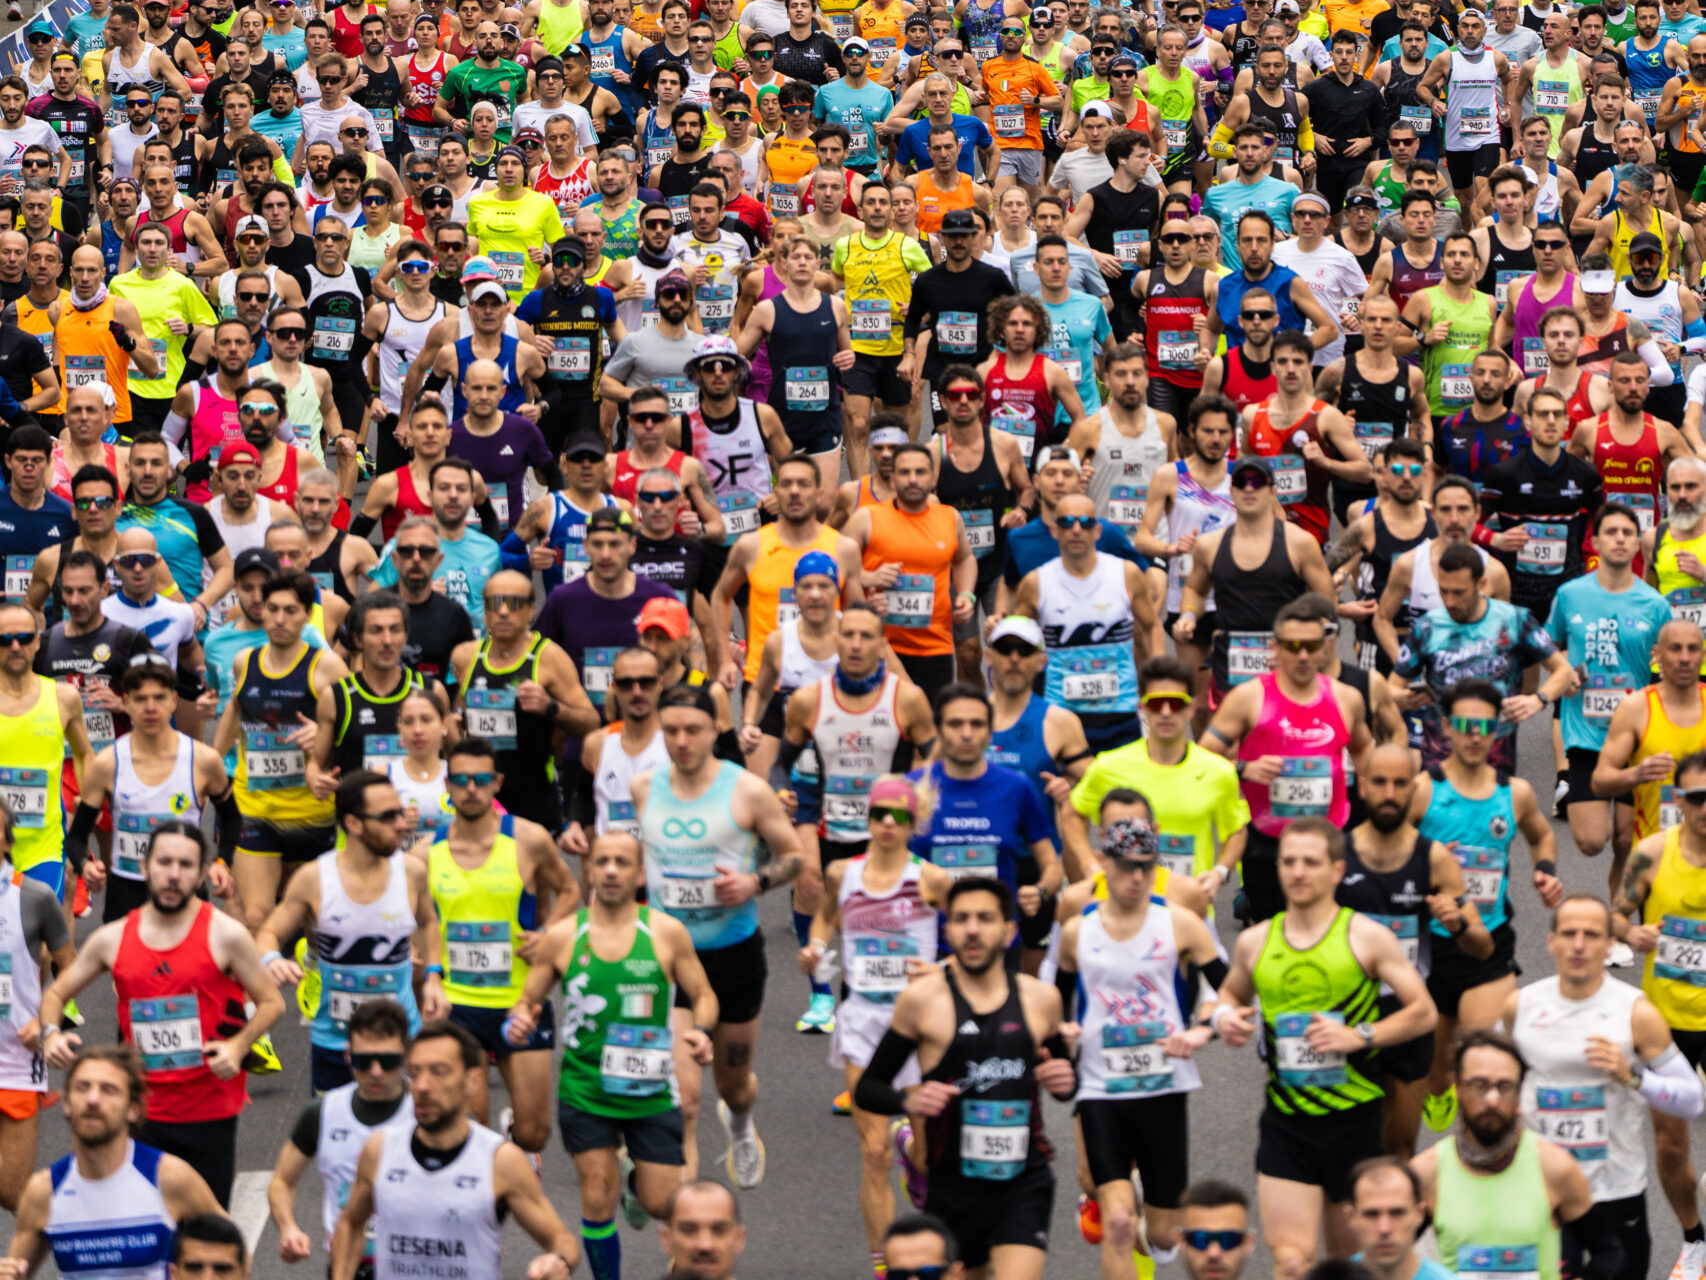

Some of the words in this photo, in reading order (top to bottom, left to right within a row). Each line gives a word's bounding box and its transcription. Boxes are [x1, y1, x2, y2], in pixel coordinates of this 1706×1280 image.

[837, 27, 850, 36] 588
[875, 51, 890, 60] 1032
[591, 59, 610, 70] 2466
[1546, 96, 1558, 105] 710
[1641, 101, 1658, 111] 1239
[849, 107, 862, 115] RO
[1001, 118, 1017, 128] 1027
[1469, 121, 1483, 130] 940
[776, 199, 794, 210] 1036
[706, 304, 722, 317] 275
[863, 316, 880, 329] 830
[326, 334, 341, 347] 216
[948, 330, 966, 342] 843
[560, 356, 578, 368] 569
[799, 386, 817, 399] 264
[730, 516, 744, 531] 311
[1533, 547, 1552, 561] 931
[1599, 618, 1618, 630] RO
[1598, 631, 1619, 643] MA
[85, 714, 111, 732] NGELO
[479, 717, 497, 733] 162
[263, 758, 288, 774] 335
[1675, 945, 1703, 967] 292
[151, 1030, 181, 1049] 306
[389, 1234, 469, 1259] CESENA
